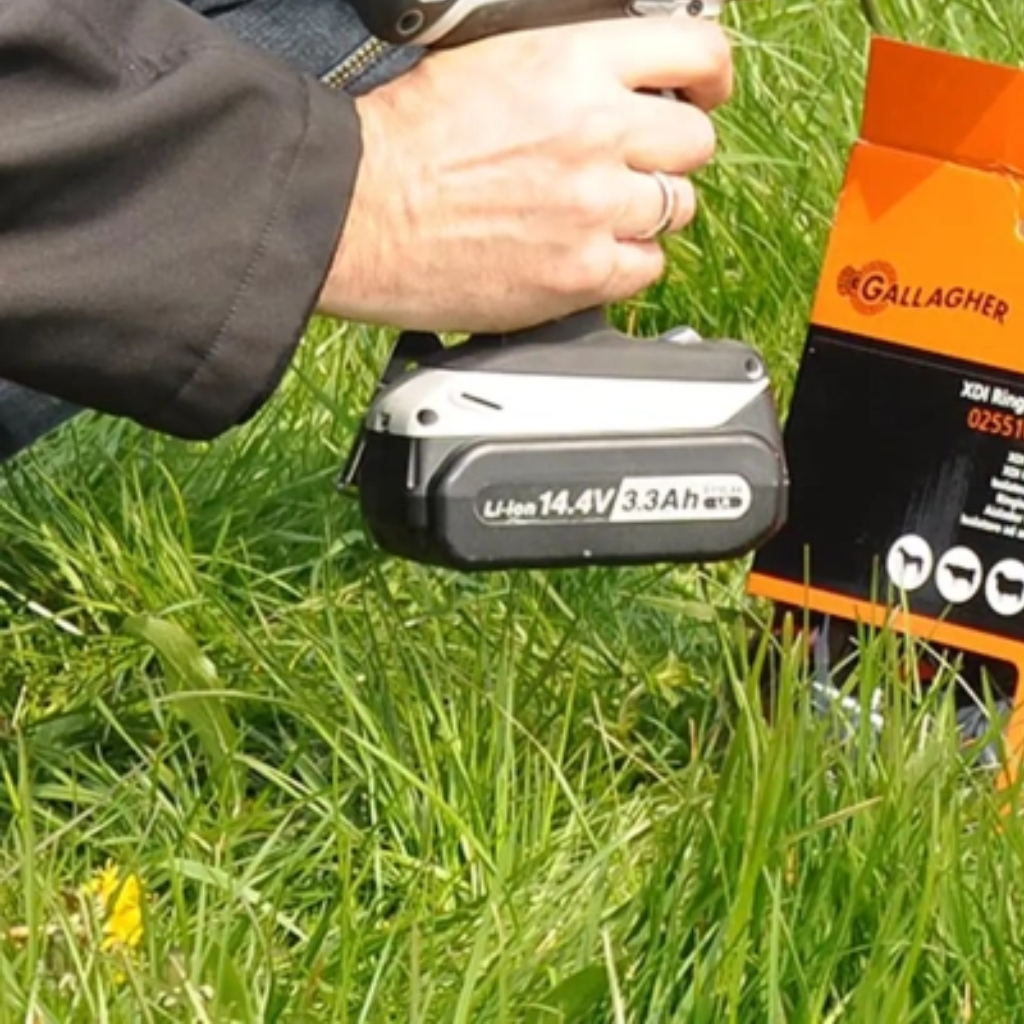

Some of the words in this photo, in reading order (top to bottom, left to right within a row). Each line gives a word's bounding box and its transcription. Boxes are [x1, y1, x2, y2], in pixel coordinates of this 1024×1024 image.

[862, 275, 1009, 324] GALLAGHER
[538, 489, 615, 515] 14.4V
[621, 488, 699, 512] 3.3Ah
